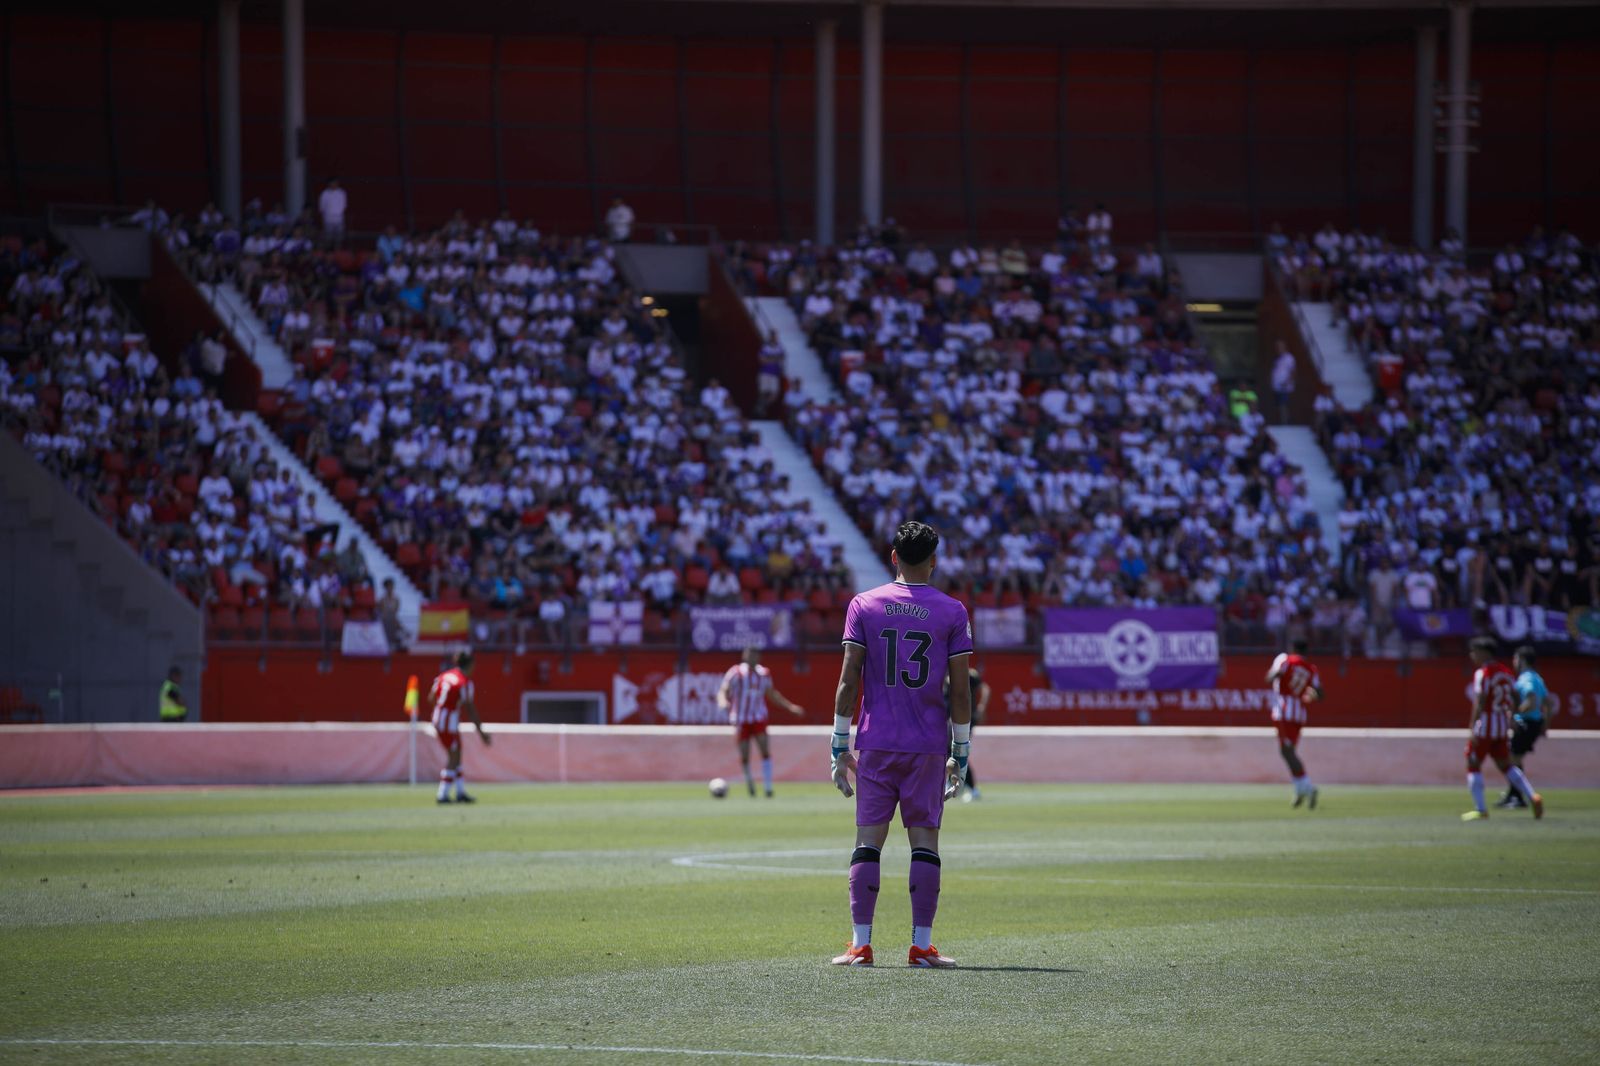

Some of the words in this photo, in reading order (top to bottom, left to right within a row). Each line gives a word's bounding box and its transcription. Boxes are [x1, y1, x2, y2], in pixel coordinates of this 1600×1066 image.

[885, 603, 930, 620] BRUNO
[879, 628, 933, 689] 13
[1031, 689, 1158, 710] ESTRELLA
